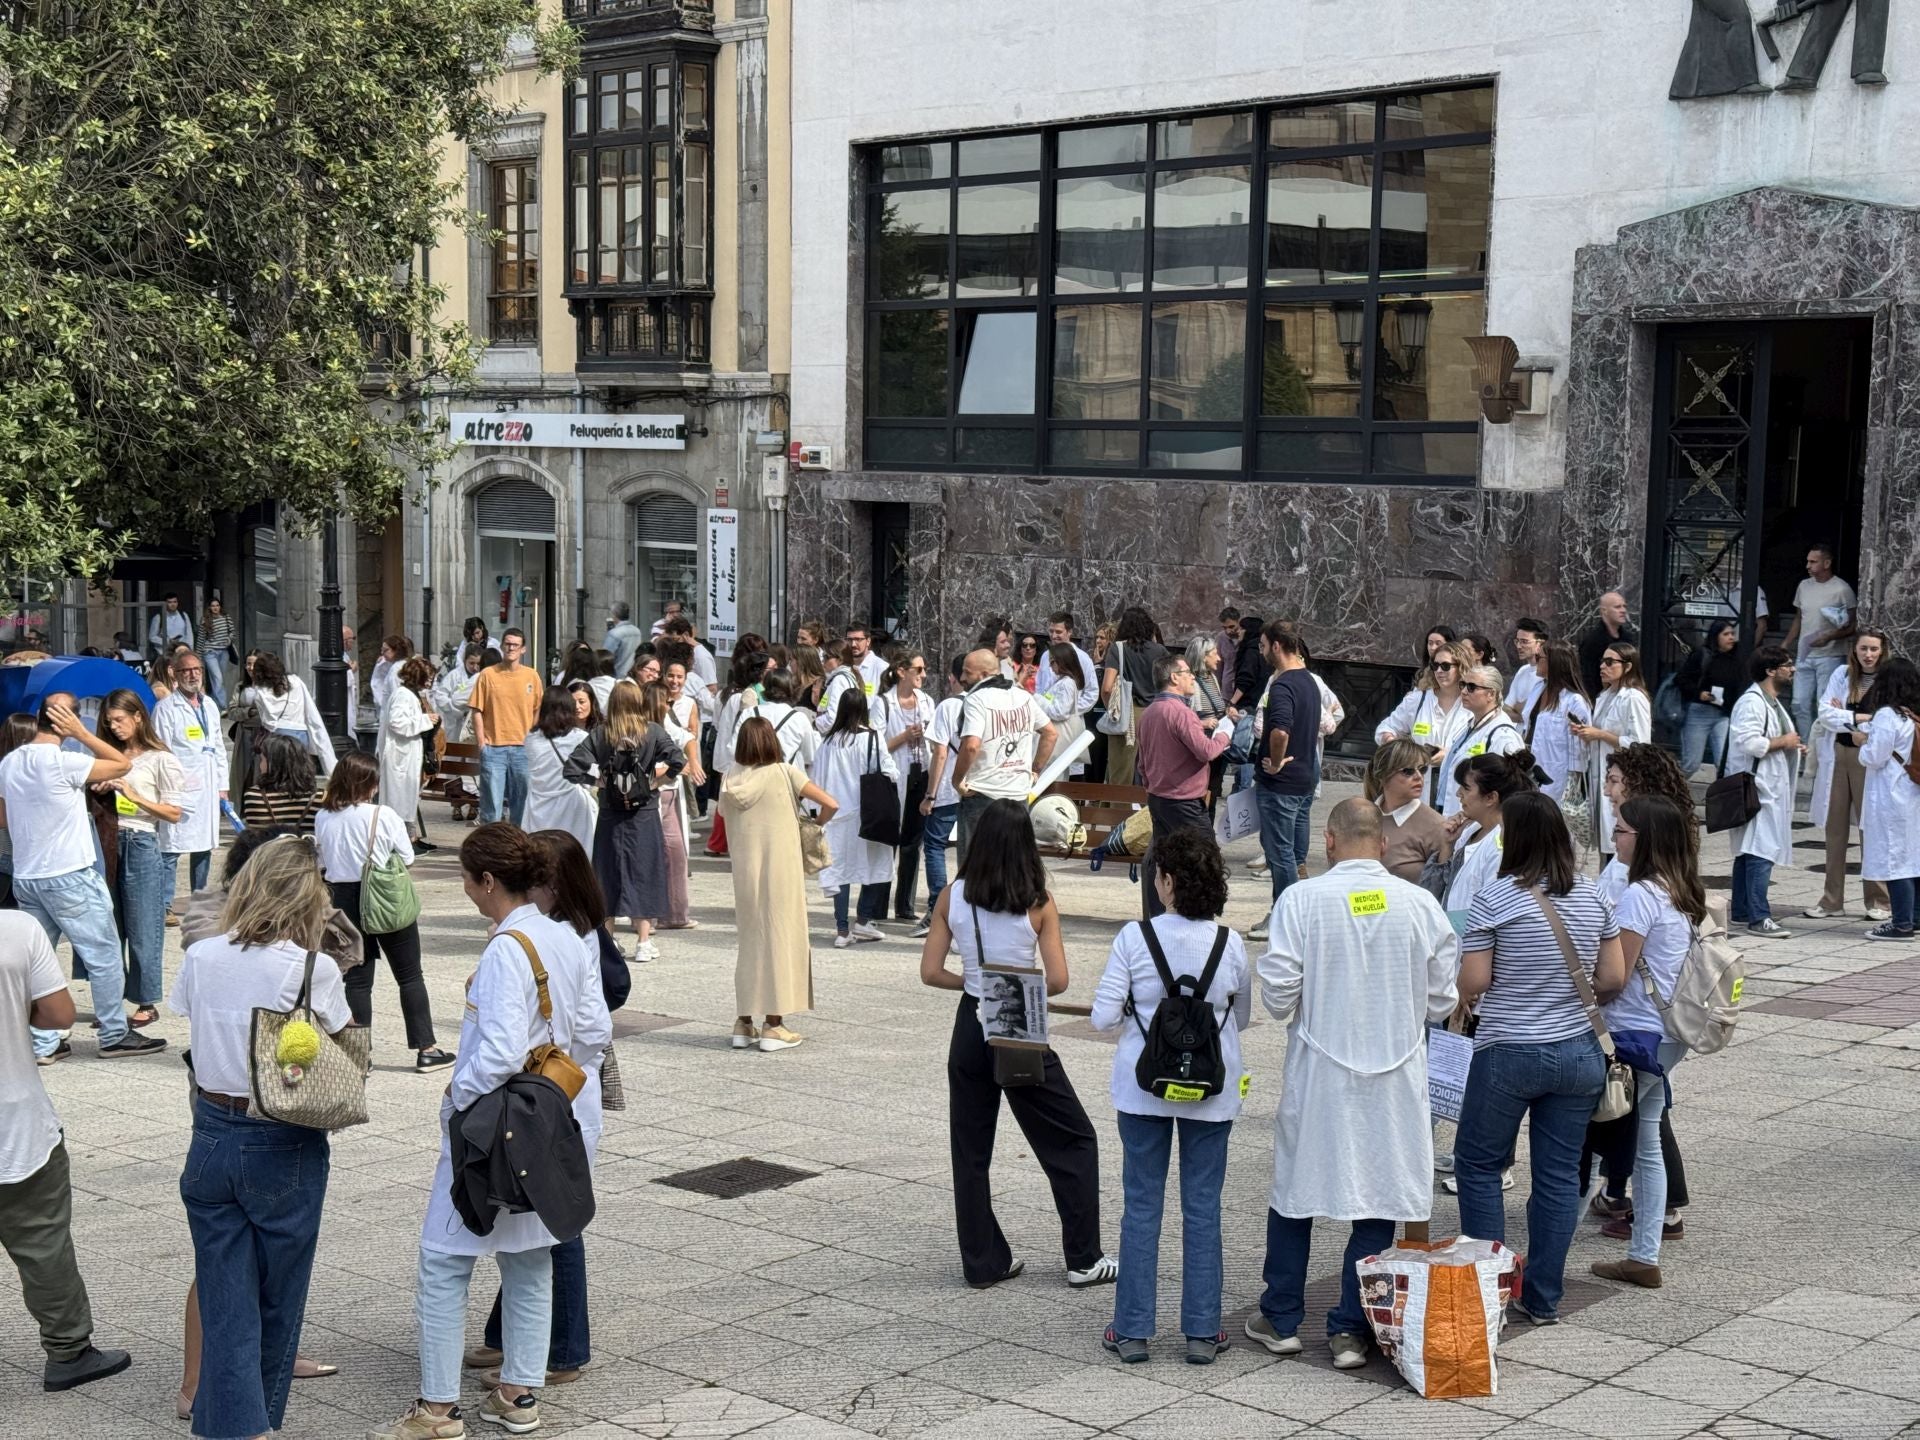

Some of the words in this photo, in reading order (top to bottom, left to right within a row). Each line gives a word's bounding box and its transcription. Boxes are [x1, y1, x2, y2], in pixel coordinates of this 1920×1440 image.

[464, 417, 533, 442] atrezzo
[570, 422, 623, 441] Peluquería
[626, 426, 634, 438] &
[637, 425, 675, 439] Belleza
[709, 514, 736, 524] atrezzo
[727, 547, 736, 603] belleza
[710, 622, 735, 632] unisex
[1353, 905, 1362, 913] EN
[1362, 903, 1386, 912] HUELGA
[1428, 1084, 1463, 1103] MÉDICO
[1430, 1103, 1447, 1113] OCTU
